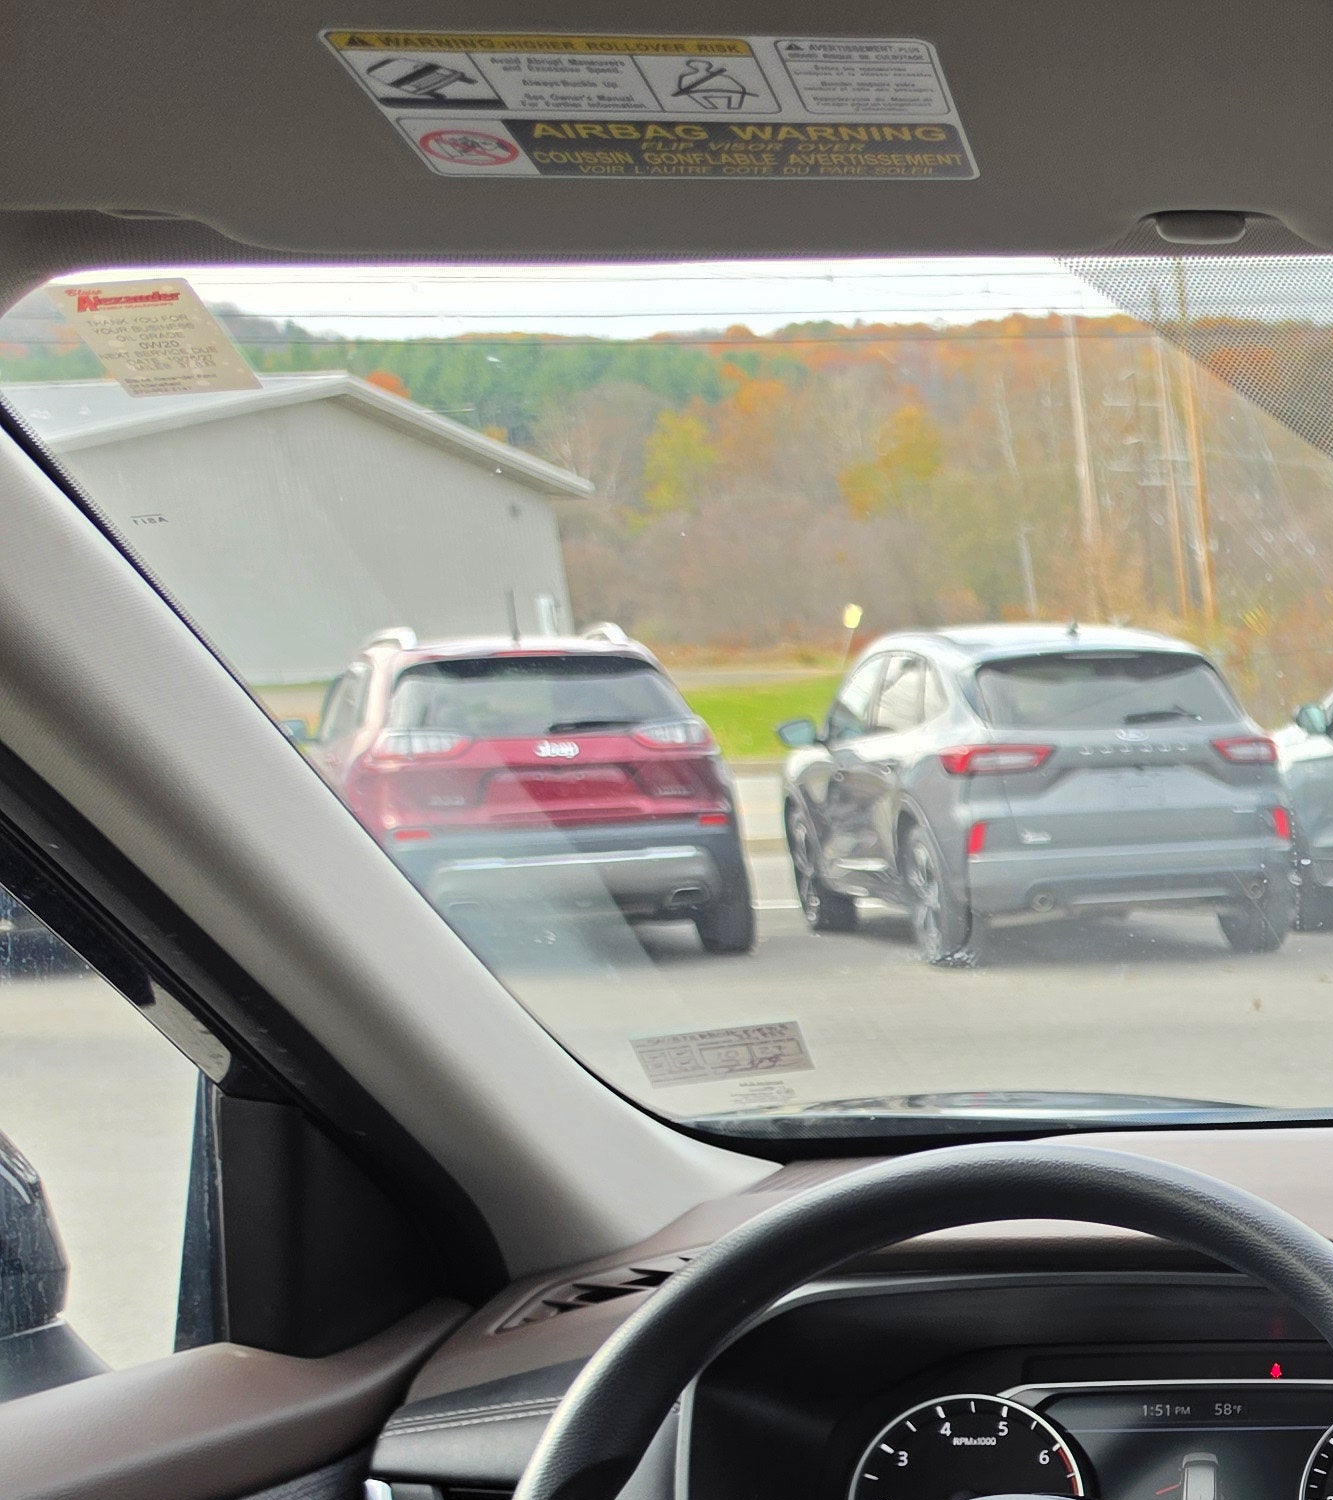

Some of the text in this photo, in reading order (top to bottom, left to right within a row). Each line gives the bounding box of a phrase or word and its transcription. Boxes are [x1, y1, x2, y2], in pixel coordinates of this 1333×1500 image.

[503, 40, 576, 51] HIGHER
[585, 41, 685, 53] ROLLOVER
[696, 43, 741, 54] RISK
[533, 123, 947, 142] AIRBAG WARNING
[641, 141, 865, 152] FLIP VISOR OVER
[533, 151, 963, 166] COUSSIN GONFLABLE AVERTISSEMENT
[579, 165, 625, 174] VOIR
[88, 319, 126, 327] THANK
[162, 314, 188, 323] FOR
[94, 326, 130, 335] YOUR
[1142, 1404, 1191, 1416] 1:51 PM
[940, 1421, 951, 1436] 4
[998, 1421, 1009, 1436] 5
[898, 1451, 908, 1466] 3
[1038, 1450, 1050, 1465] 6
